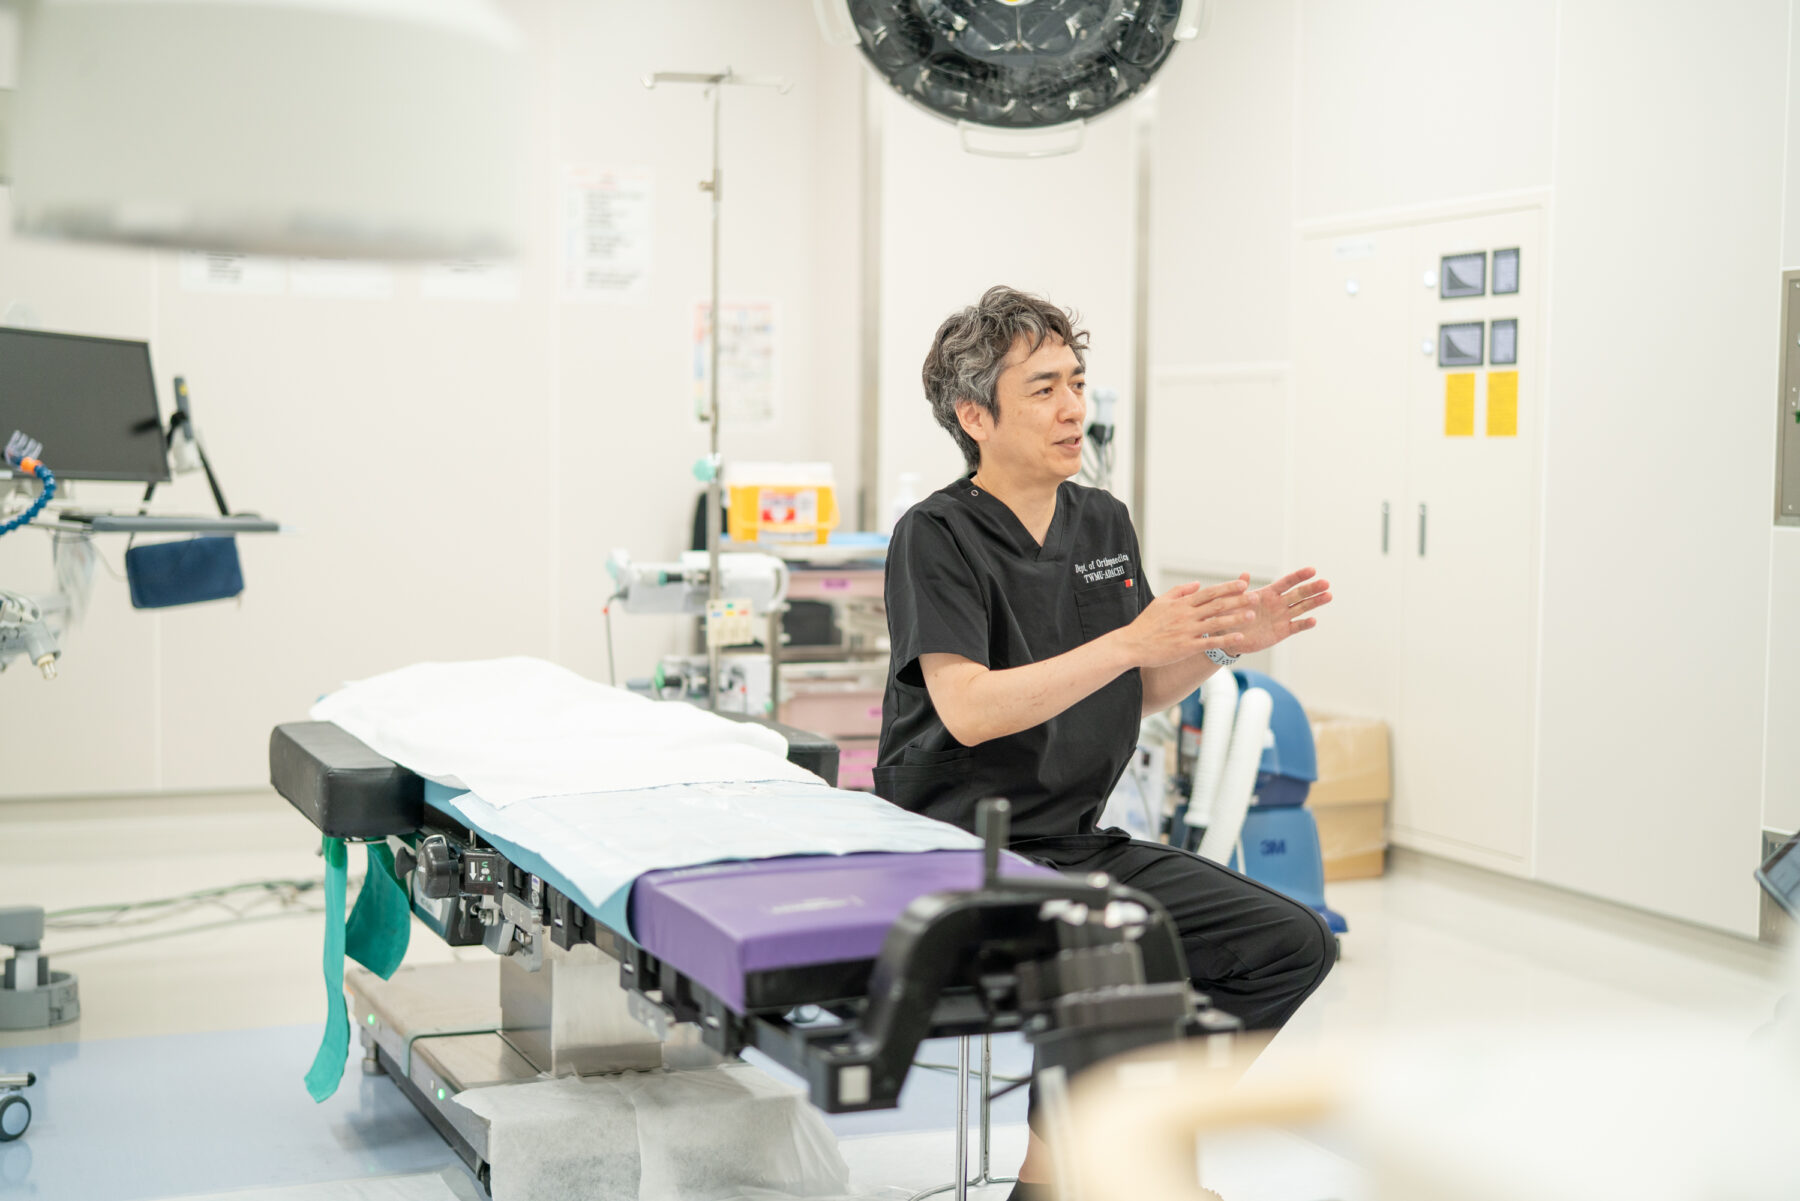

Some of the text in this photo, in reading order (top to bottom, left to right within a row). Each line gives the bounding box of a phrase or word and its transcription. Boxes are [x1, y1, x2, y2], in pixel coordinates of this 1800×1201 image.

[1083, 565, 1125, 583] TWMU-ADACHI
[1088, 561, 1095, 570] of
[1259, 838, 1287, 856] 3M
